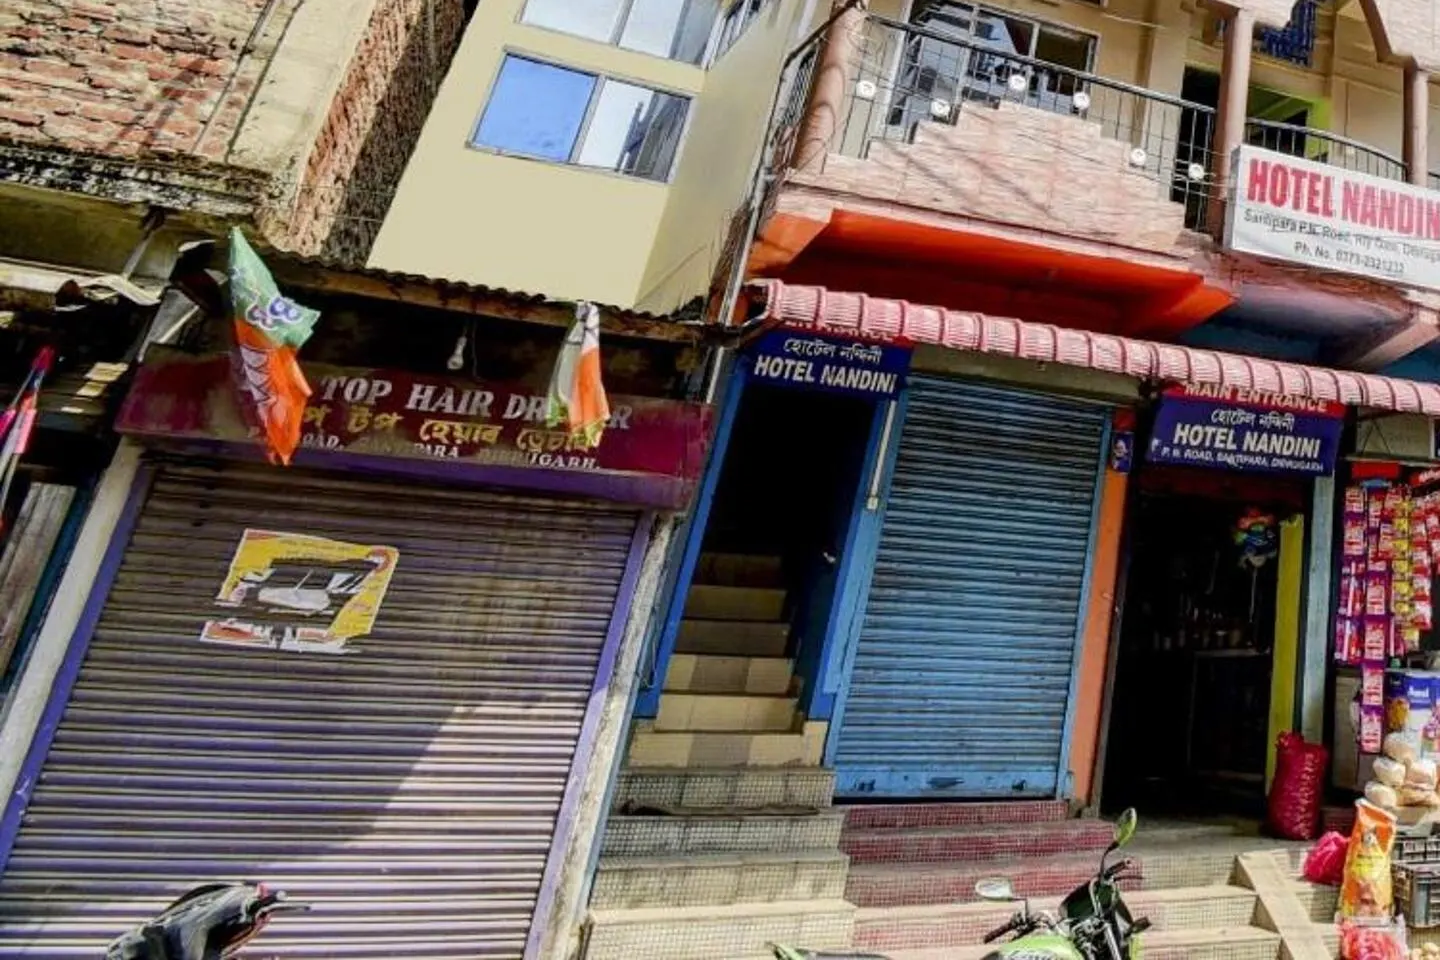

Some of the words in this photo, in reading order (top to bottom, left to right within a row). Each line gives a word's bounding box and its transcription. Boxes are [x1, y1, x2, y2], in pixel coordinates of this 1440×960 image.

[1247, 159, 1334, 217] HOTEL
[754, 354, 815, 383] HOTEL
[820, 365, 897, 394] NANDINI
[320, 376, 393, 405] TOP
[405, 383, 495, 418] HAIR
[1184, 382, 1232, 400] MAIN
[1238, 387, 1328, 412] ENTRANCE
[1173, 422, 1237, 451] HOTEL
[1243, 431, 1322, 459] NANDINI
